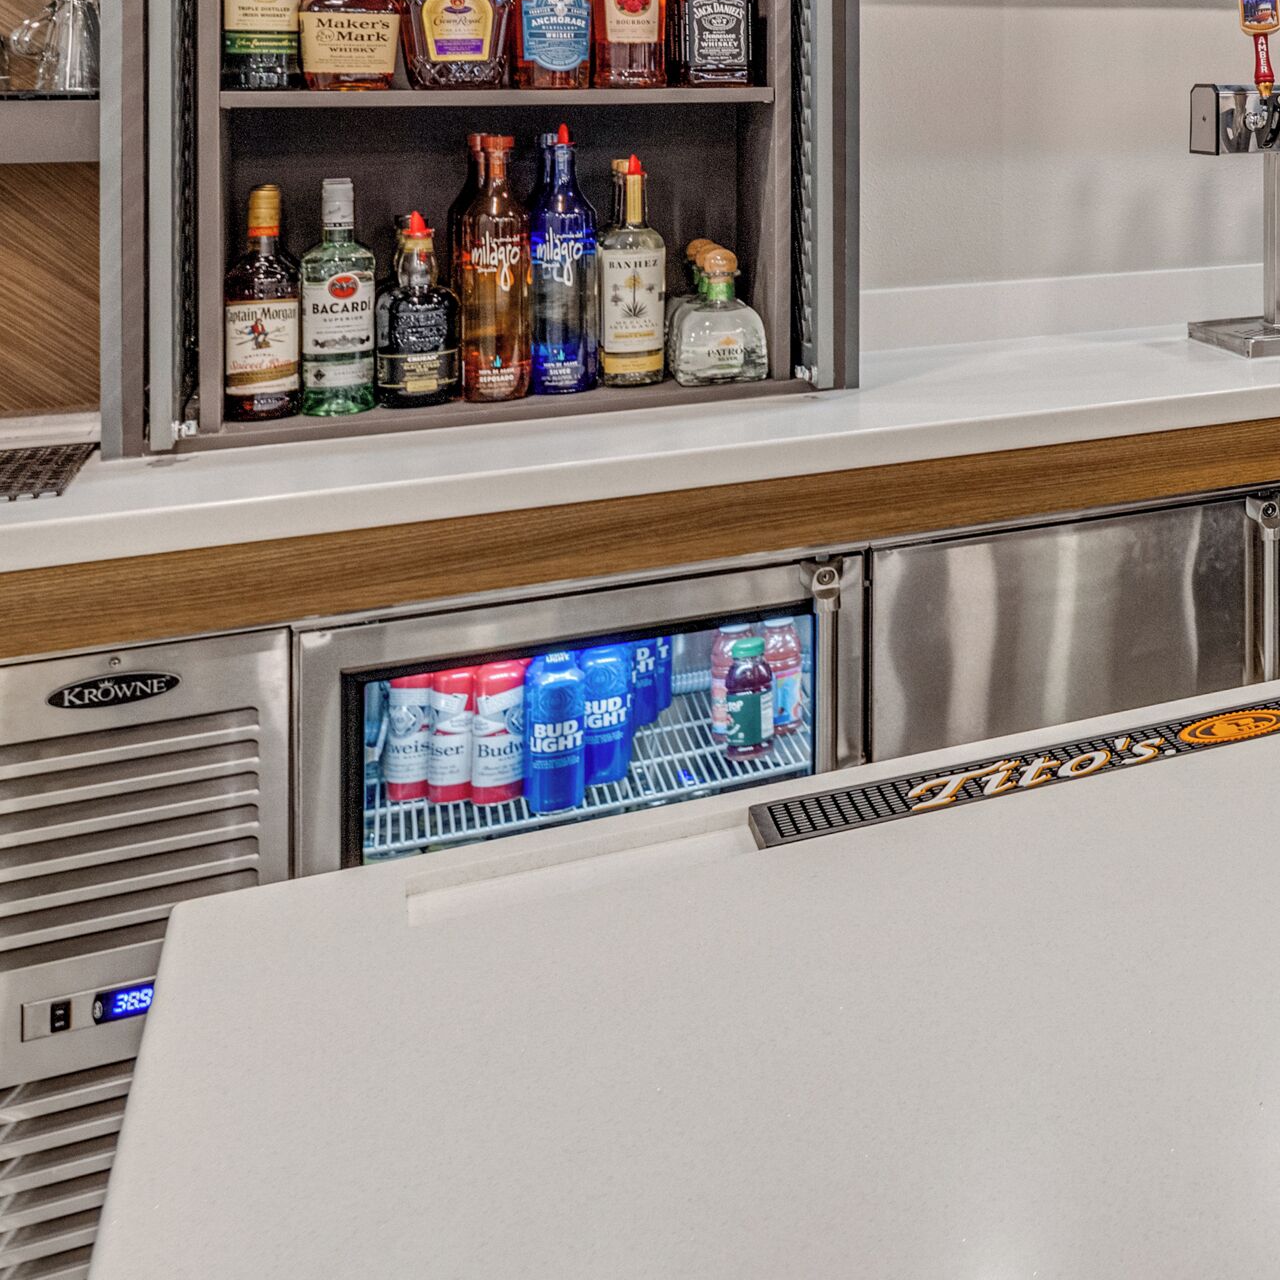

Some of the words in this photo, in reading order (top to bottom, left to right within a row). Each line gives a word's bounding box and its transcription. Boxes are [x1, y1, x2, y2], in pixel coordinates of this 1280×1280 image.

[693, 4, 714, 19] JACK
[713, 2, 745, 19] DANIEL'S
[315, 18, 391, 30] Maker's
[531, 15, 587, 28] ANCHORAGE
[336, 31, 389, 42] Mark
[328, 46, 377, 54] WHISKY
[1257, 36, 1268, 74] AMBER
[471, 231, 521, 292] milagro
[536, 226, 584, 287] milagro
[608, 259, 659, 269] BANHEZ
[312, 295, 371, 315] BACARDÍ
[479, 374, 515, 383] REPOSADO
[545, 653, 570, 664] LIGHT
[62, 676, 168, 708] KROWNE
[584, 707, 627, 730] IGHT
[533, 719, 579, 738] BUD
[530, 730, 584, 753] LIGHT
